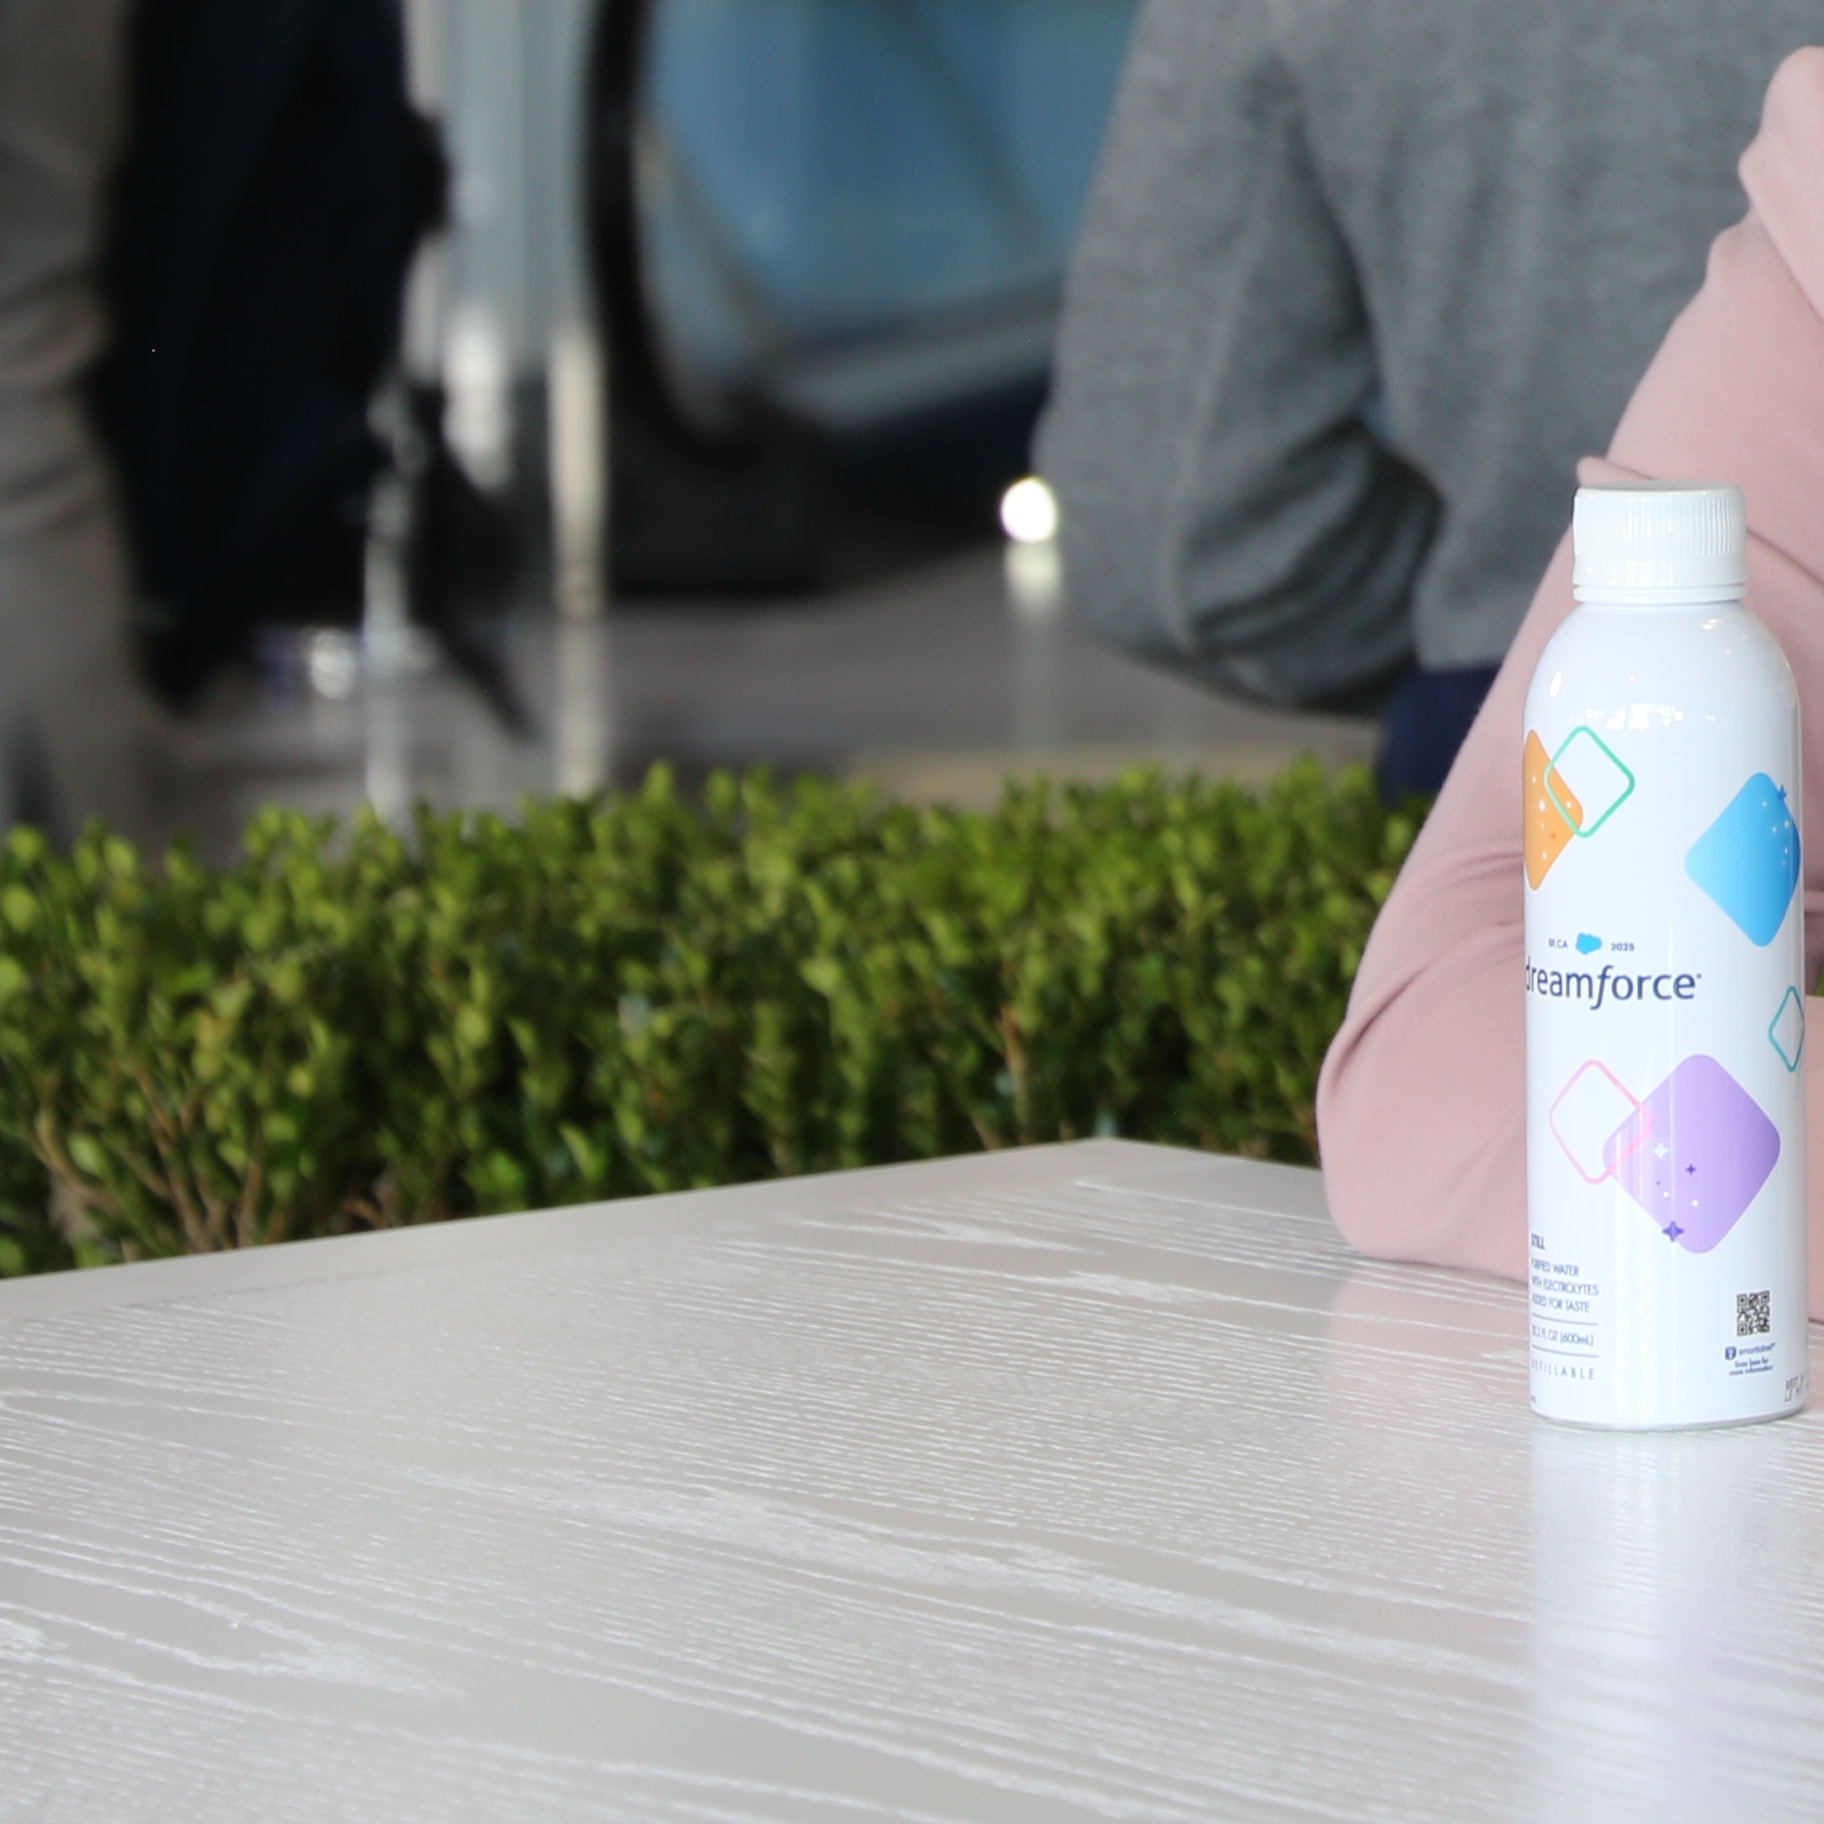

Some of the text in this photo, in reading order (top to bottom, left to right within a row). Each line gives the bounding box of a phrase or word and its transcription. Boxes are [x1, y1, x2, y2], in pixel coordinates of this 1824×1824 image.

[1610, 942, 1635, 952] 2025
[1552, 1263, 1580, 1277] WATER
[1543, 1278, 1599, 1296] ELECTROLYTES
[1548, 1297, 1563, 1311] FOR
[1564, 1299, 1591, 1314] TASTE
